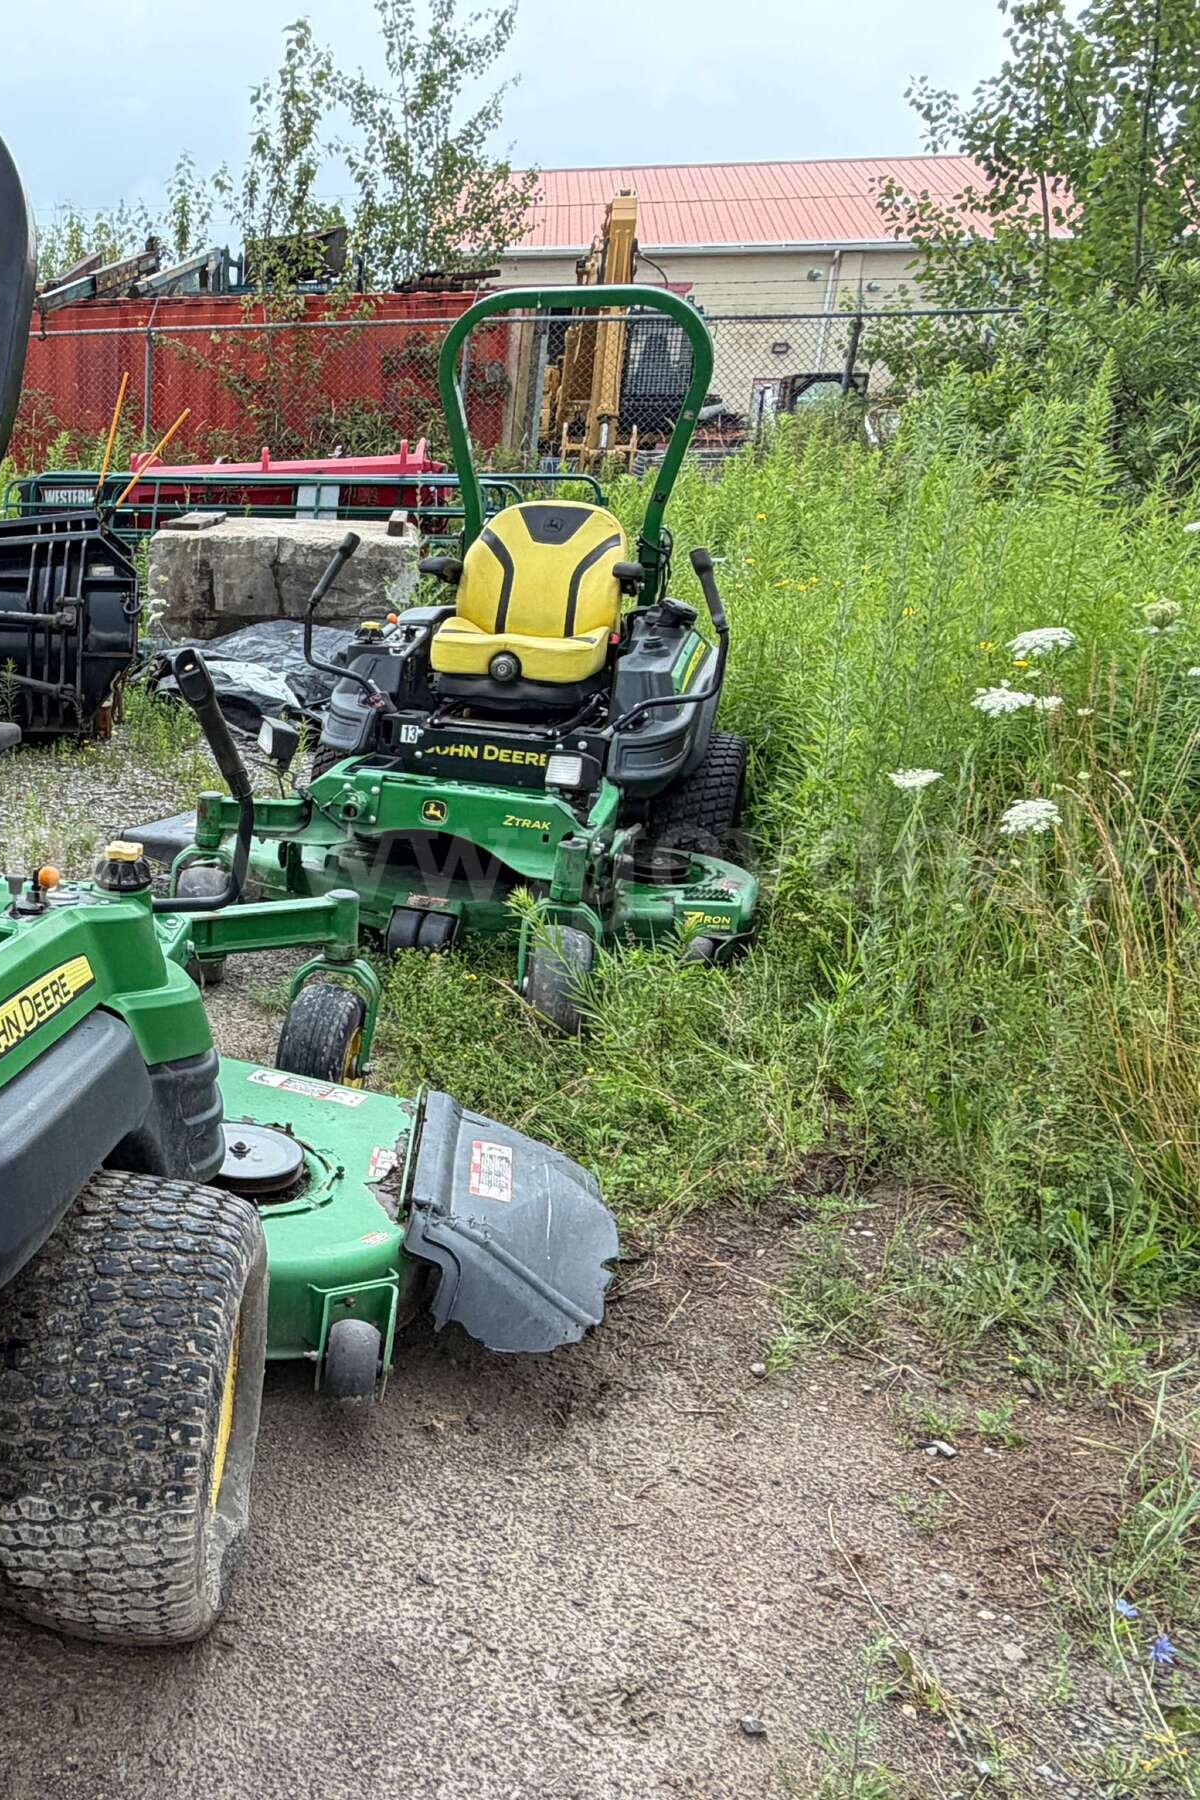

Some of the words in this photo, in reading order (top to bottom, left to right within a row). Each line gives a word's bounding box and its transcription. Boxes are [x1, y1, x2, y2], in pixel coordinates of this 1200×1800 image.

[44, 488, 94, 504] WESTERN
[404, 726, 417, 742] 13
[502, 815, 551, 831] ZTRAK
[19, 973, 71, 1028] DEERE
